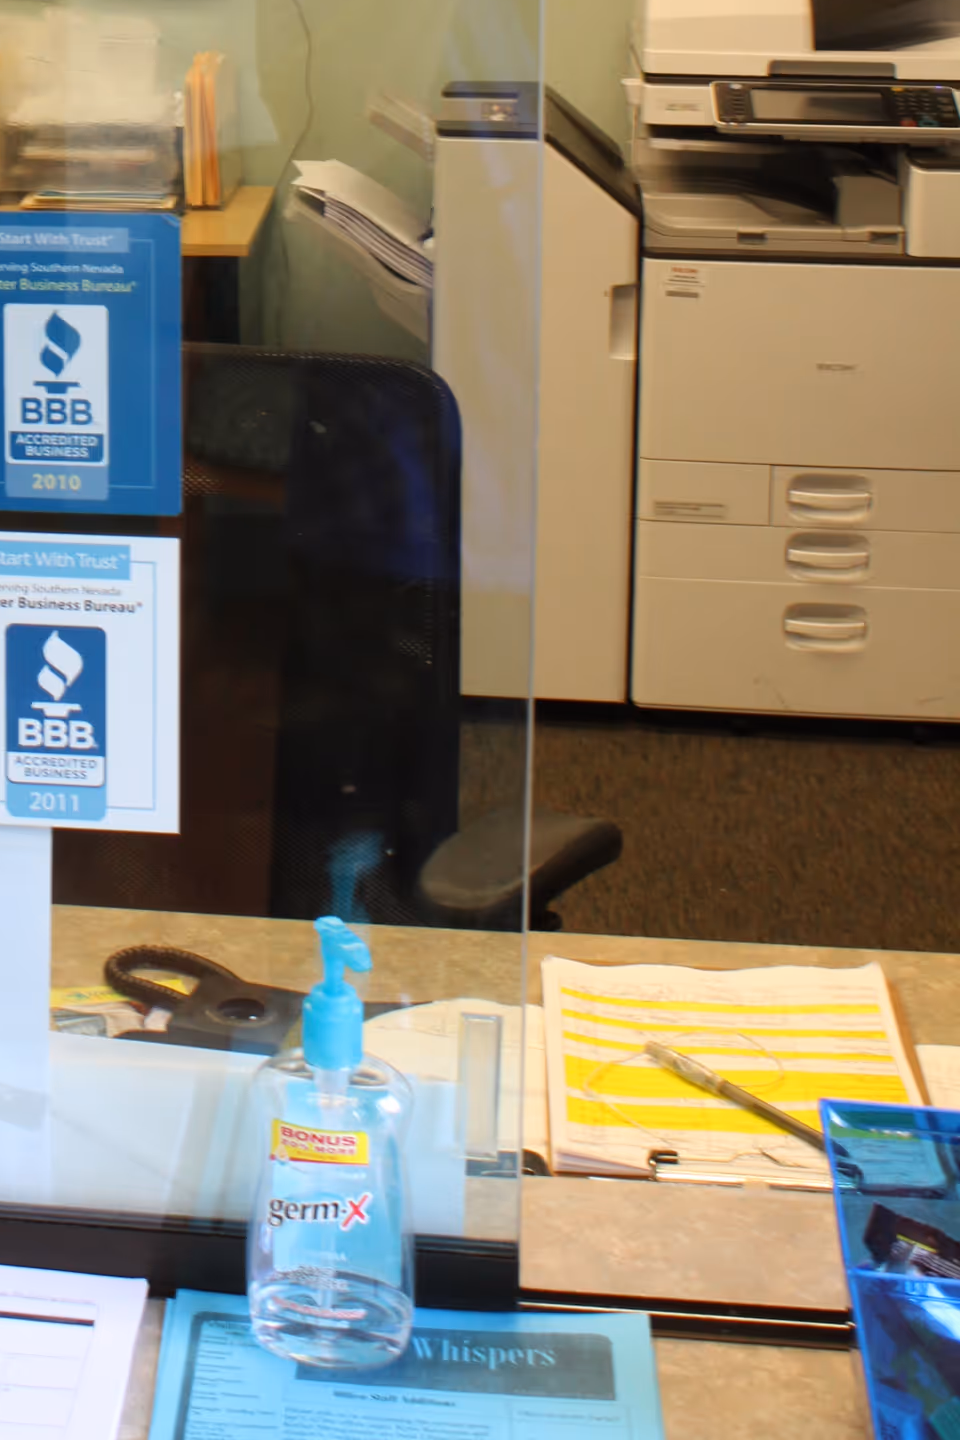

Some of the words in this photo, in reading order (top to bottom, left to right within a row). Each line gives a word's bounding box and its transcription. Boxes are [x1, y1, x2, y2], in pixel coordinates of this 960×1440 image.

[21, 398, 92, 424] BBB
[16, 435, 97, 446] ACCREDITED
[25, 446, 88, 457] BUSINESS
[32, 474, 81, 490] 2010
[18, 718, 94, 749] BBB
[15, 757, 97, 768] ACCREDITED
[24, 768, 87, 779] BUSINESS
[29, 792, 79, 811] 2011
[281, 1126, 356, 1146] BONUS
[412, 1335, 557, 1369] Whispers
